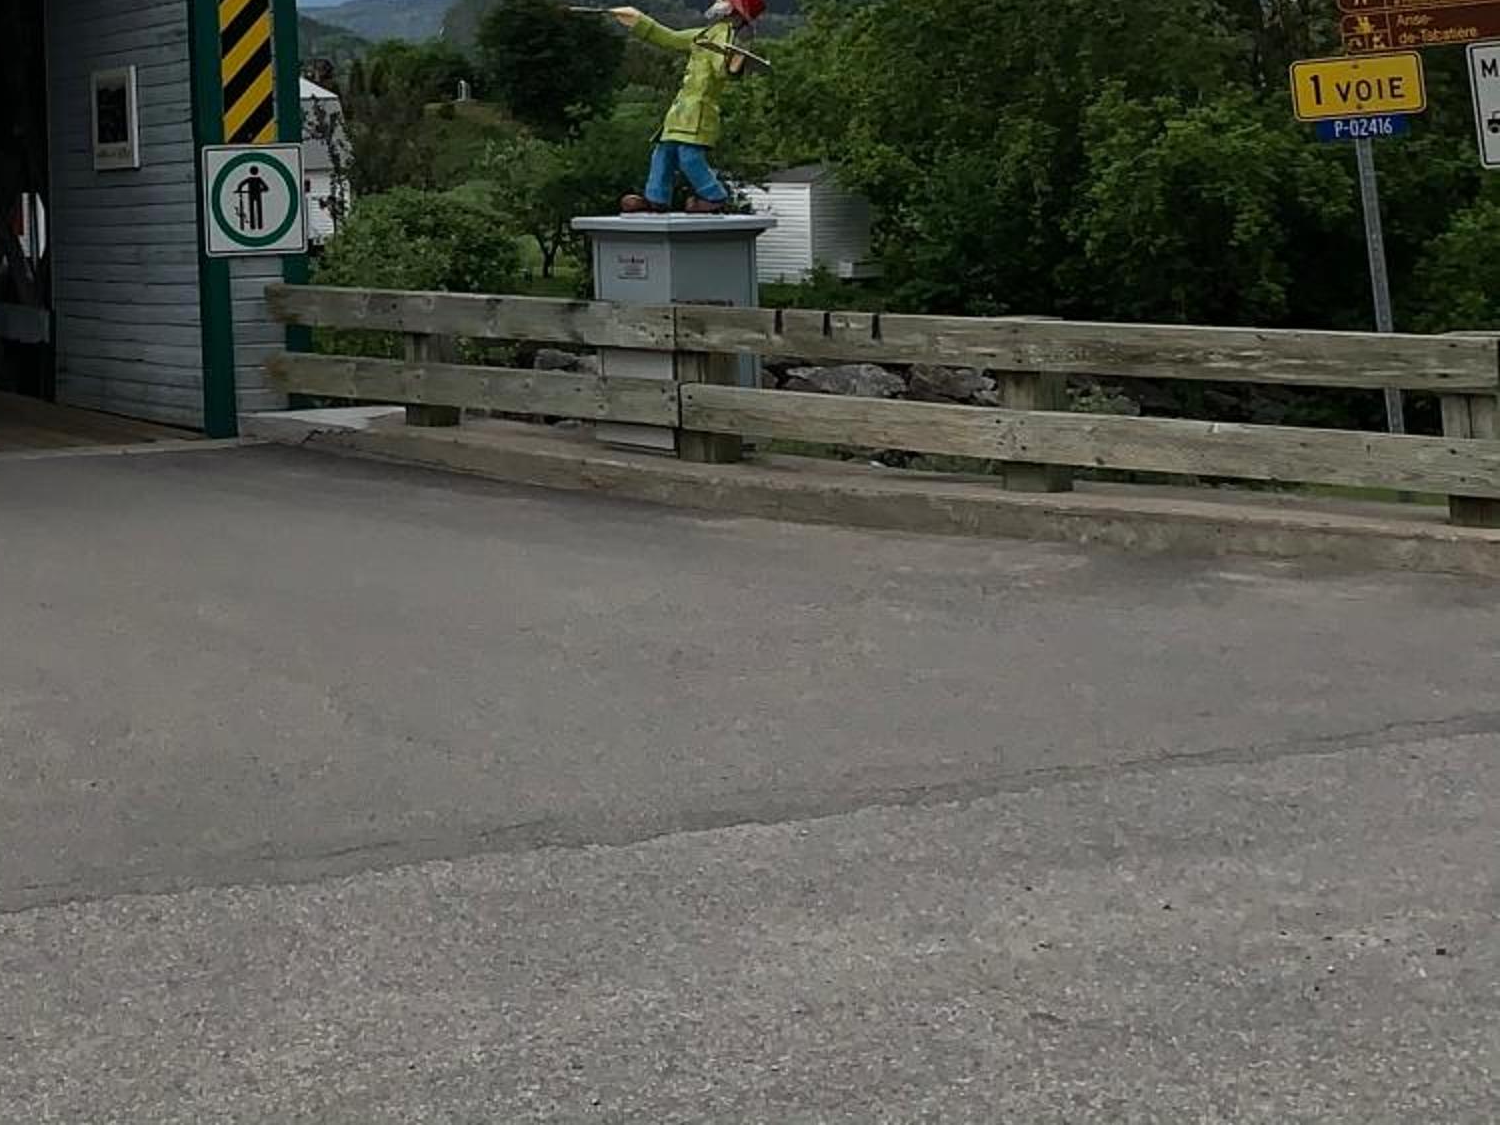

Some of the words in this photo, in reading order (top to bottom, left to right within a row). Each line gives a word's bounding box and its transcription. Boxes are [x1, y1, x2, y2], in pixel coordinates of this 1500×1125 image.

[1309, 74, 1323, 106] 1
[1336, 76, 1405, 103] VOIE
[1333, 117, 1394, 139] P-02416
